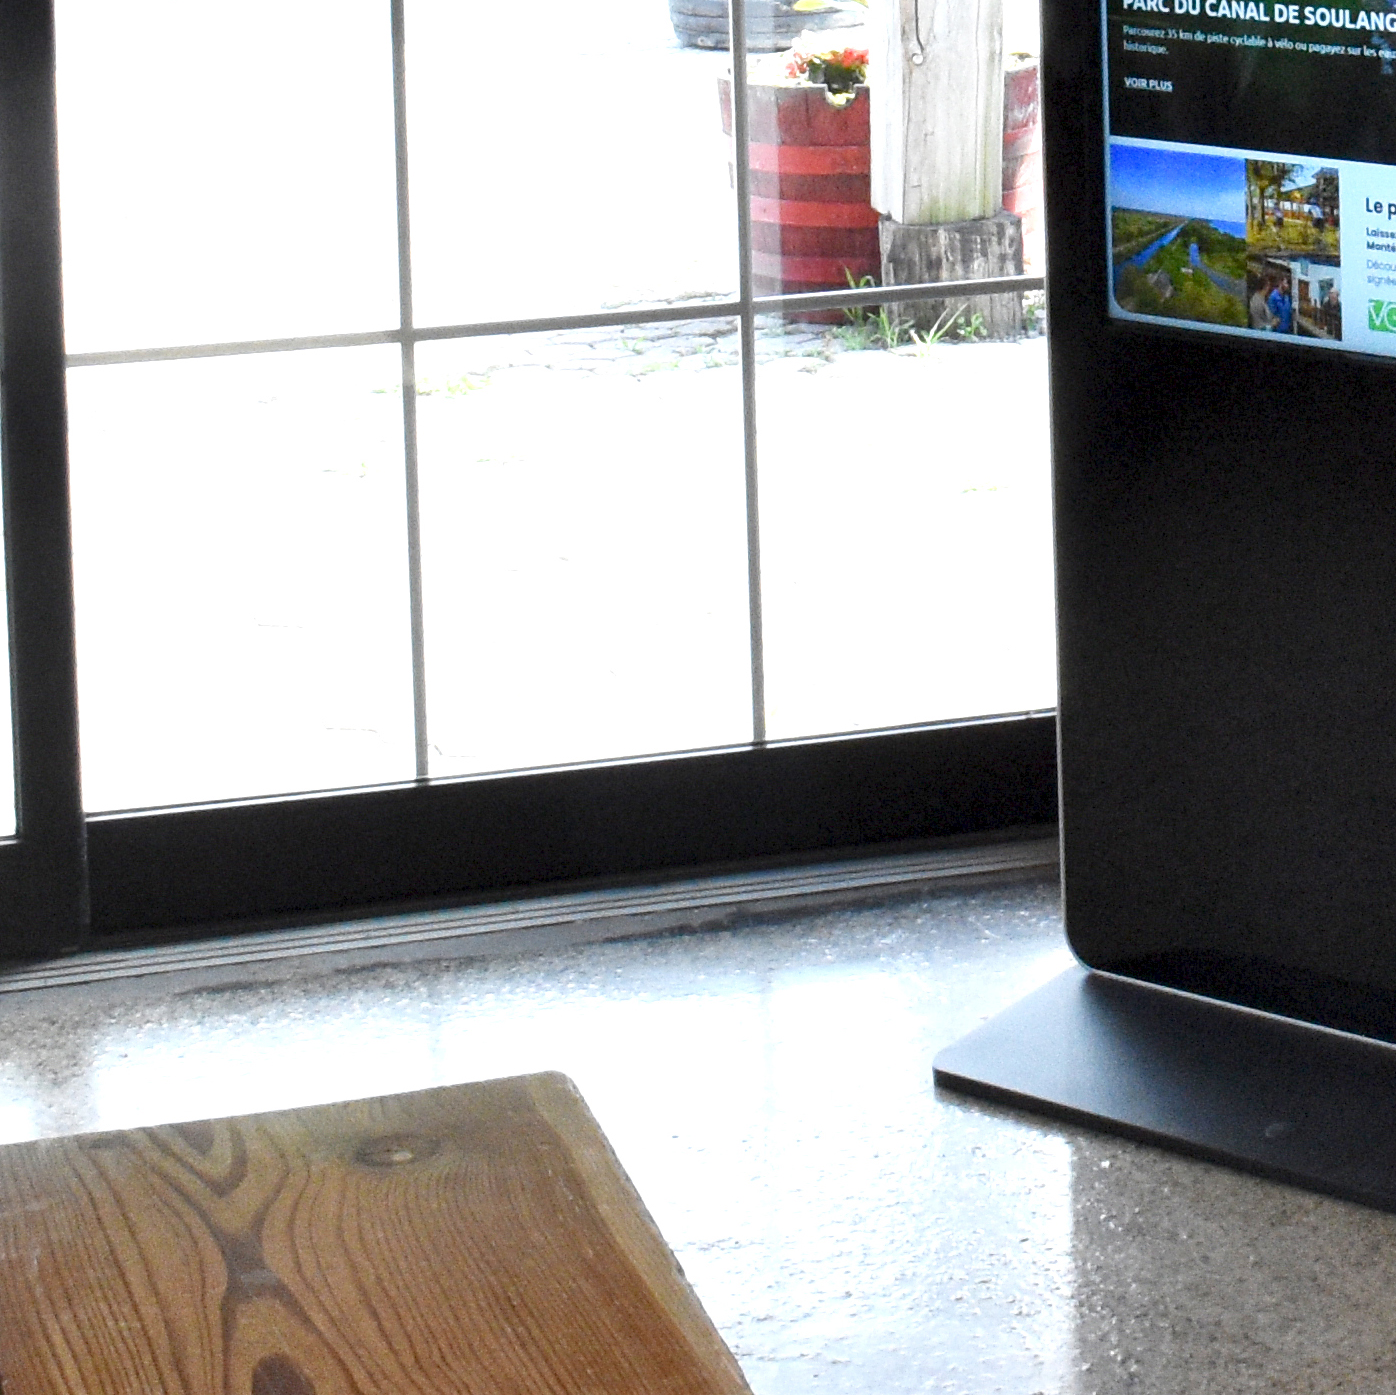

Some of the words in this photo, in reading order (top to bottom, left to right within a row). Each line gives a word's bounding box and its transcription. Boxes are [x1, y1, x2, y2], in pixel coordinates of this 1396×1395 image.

[1274, 3, 1300, 24] DE
[1123, 25, 1165, 39] Parcourez
[1179, 29, 1192, 41] km
[1194, 31, 1206, 42] de
[1207, 32, 1229, 45] piste
[1230, 35, 1266, 48] cyclable
[1267, 37, 1273, 48] à
[1274, 37, 1294, 50] vélo
[1295, 42, 1307, 51] ou
[1308, 44, 1346, 55] pagayez
[1347, 46, 1362, 56] sur
[1363, 45, 1377, 57] les
[1123, 40, 1169, 55] historique.
[1124, 76, 1147, 89] VOIR
[1149, 79, 1173, 91] PLUS
[1365, 197, 1383, 214] Le
